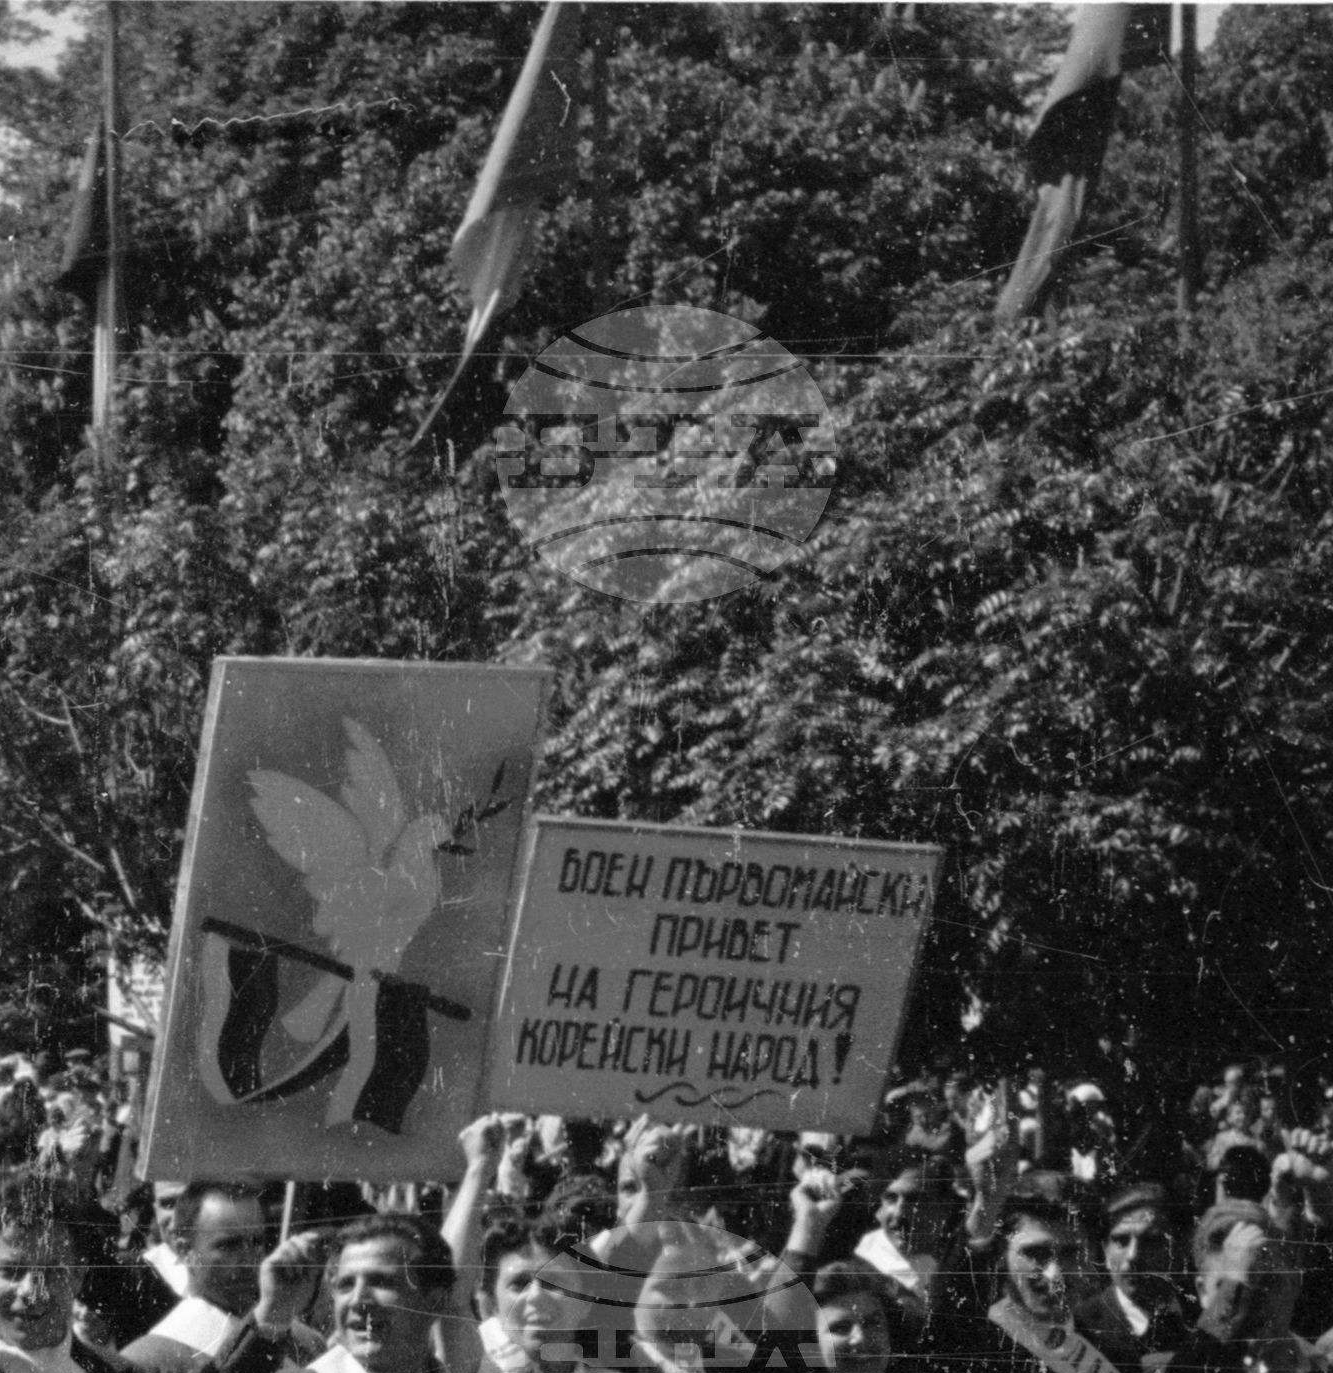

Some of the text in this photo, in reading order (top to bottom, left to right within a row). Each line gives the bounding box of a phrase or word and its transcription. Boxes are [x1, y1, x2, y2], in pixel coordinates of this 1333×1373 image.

[649, 912, 802, 964] ПРИВЕТ
[547, 962, 862, 1031] НА ГЕРОИЧНИЯ
[515, 1015, 692, 1077] КОРЕЙСКИ
